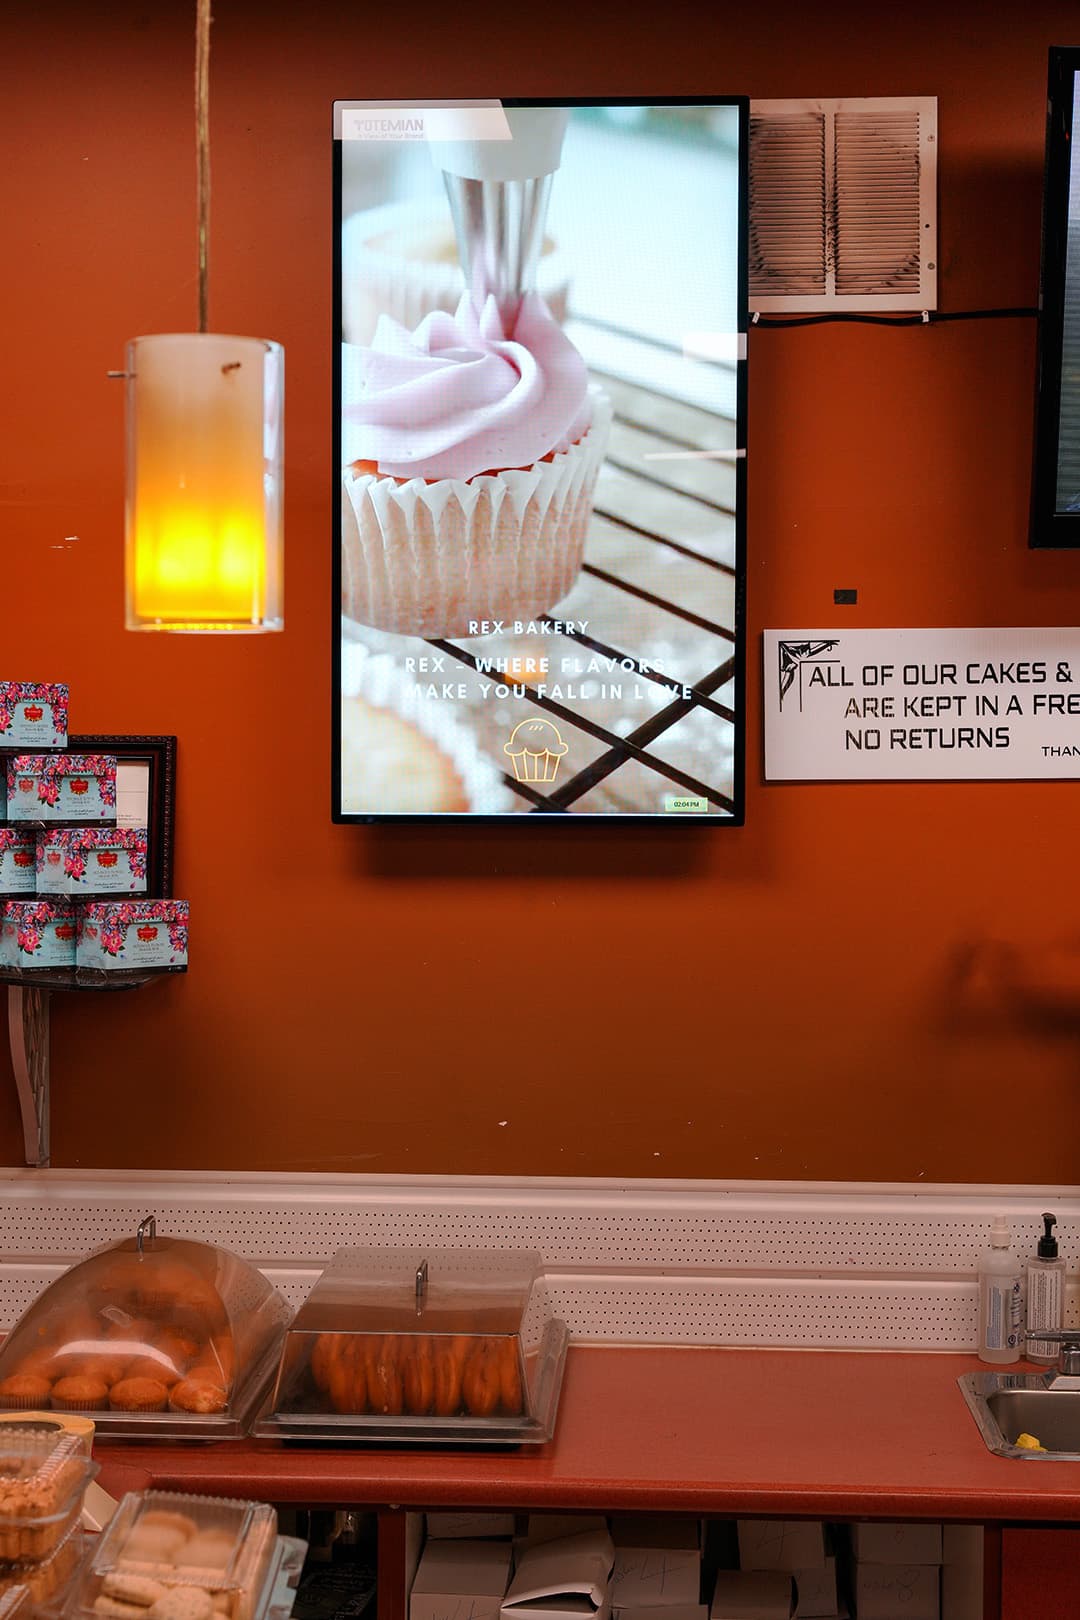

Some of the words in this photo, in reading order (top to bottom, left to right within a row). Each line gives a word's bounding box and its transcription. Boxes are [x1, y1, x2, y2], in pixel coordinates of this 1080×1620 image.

[468, 620, 504, 635] REX
[514, 620, 589, 635] BAKERY
[405, 657, 445, 673] REX
[475, 657, 549, 673] WHERE
[561, 657, 666, 674] FLAVORS
[809, 666, 854, 688] ALL
[862, 665, 894, 687] OF
[903, 664, 958, 686] OUR
[966, 662, 1047, 684] CAKES
[1055, 662, 1073, 683] &
[479, 683, 526, 699] YOU
[537, 684, 589, 699] FALL
[602, 684, 622, 699] IN
[635, 684, 692, 700] LVE
[844, 697, 895, 719] ARE
[903, 695, 967, 718] KEPT
[976, 695, 999, 717] IN
[1006, 694, 1023, 716] A
[845, 729, 881, 750] NO
[890, 727, 1010, 749] RETURNS
